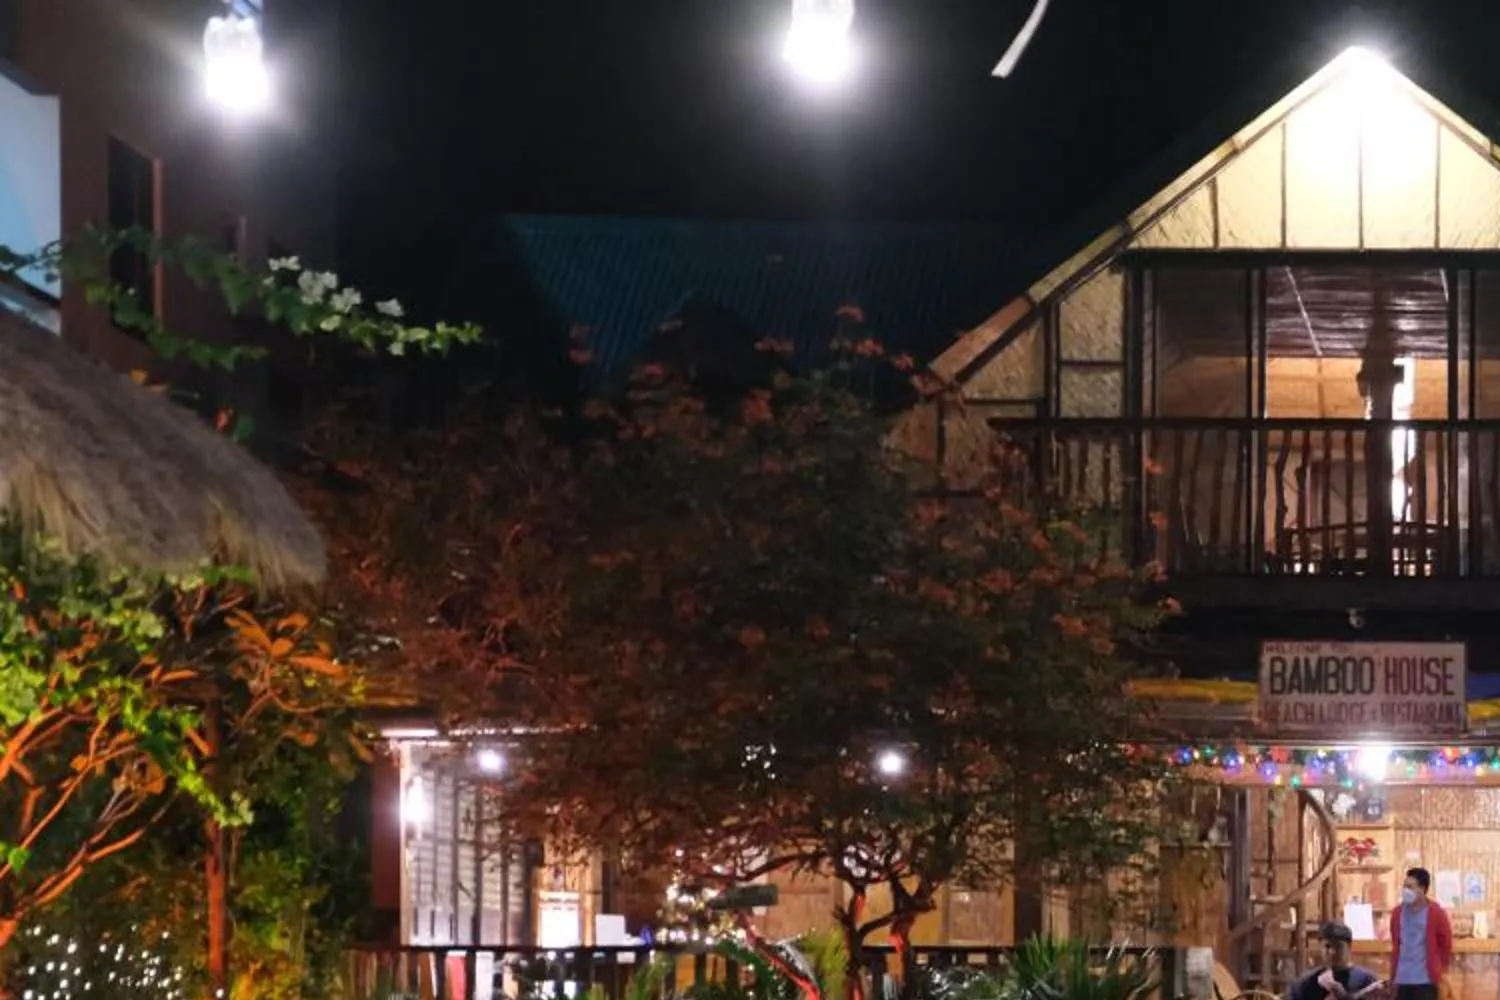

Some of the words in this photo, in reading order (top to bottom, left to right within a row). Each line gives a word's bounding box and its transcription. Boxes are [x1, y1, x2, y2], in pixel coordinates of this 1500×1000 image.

[1269, 655, 1375, 696] BAMBOO
[1384, 655, 1455, 696] HOUSE
[1259, 700, 1315, 723] BEACH
[1318, 700, 1367, 723] LODGE
